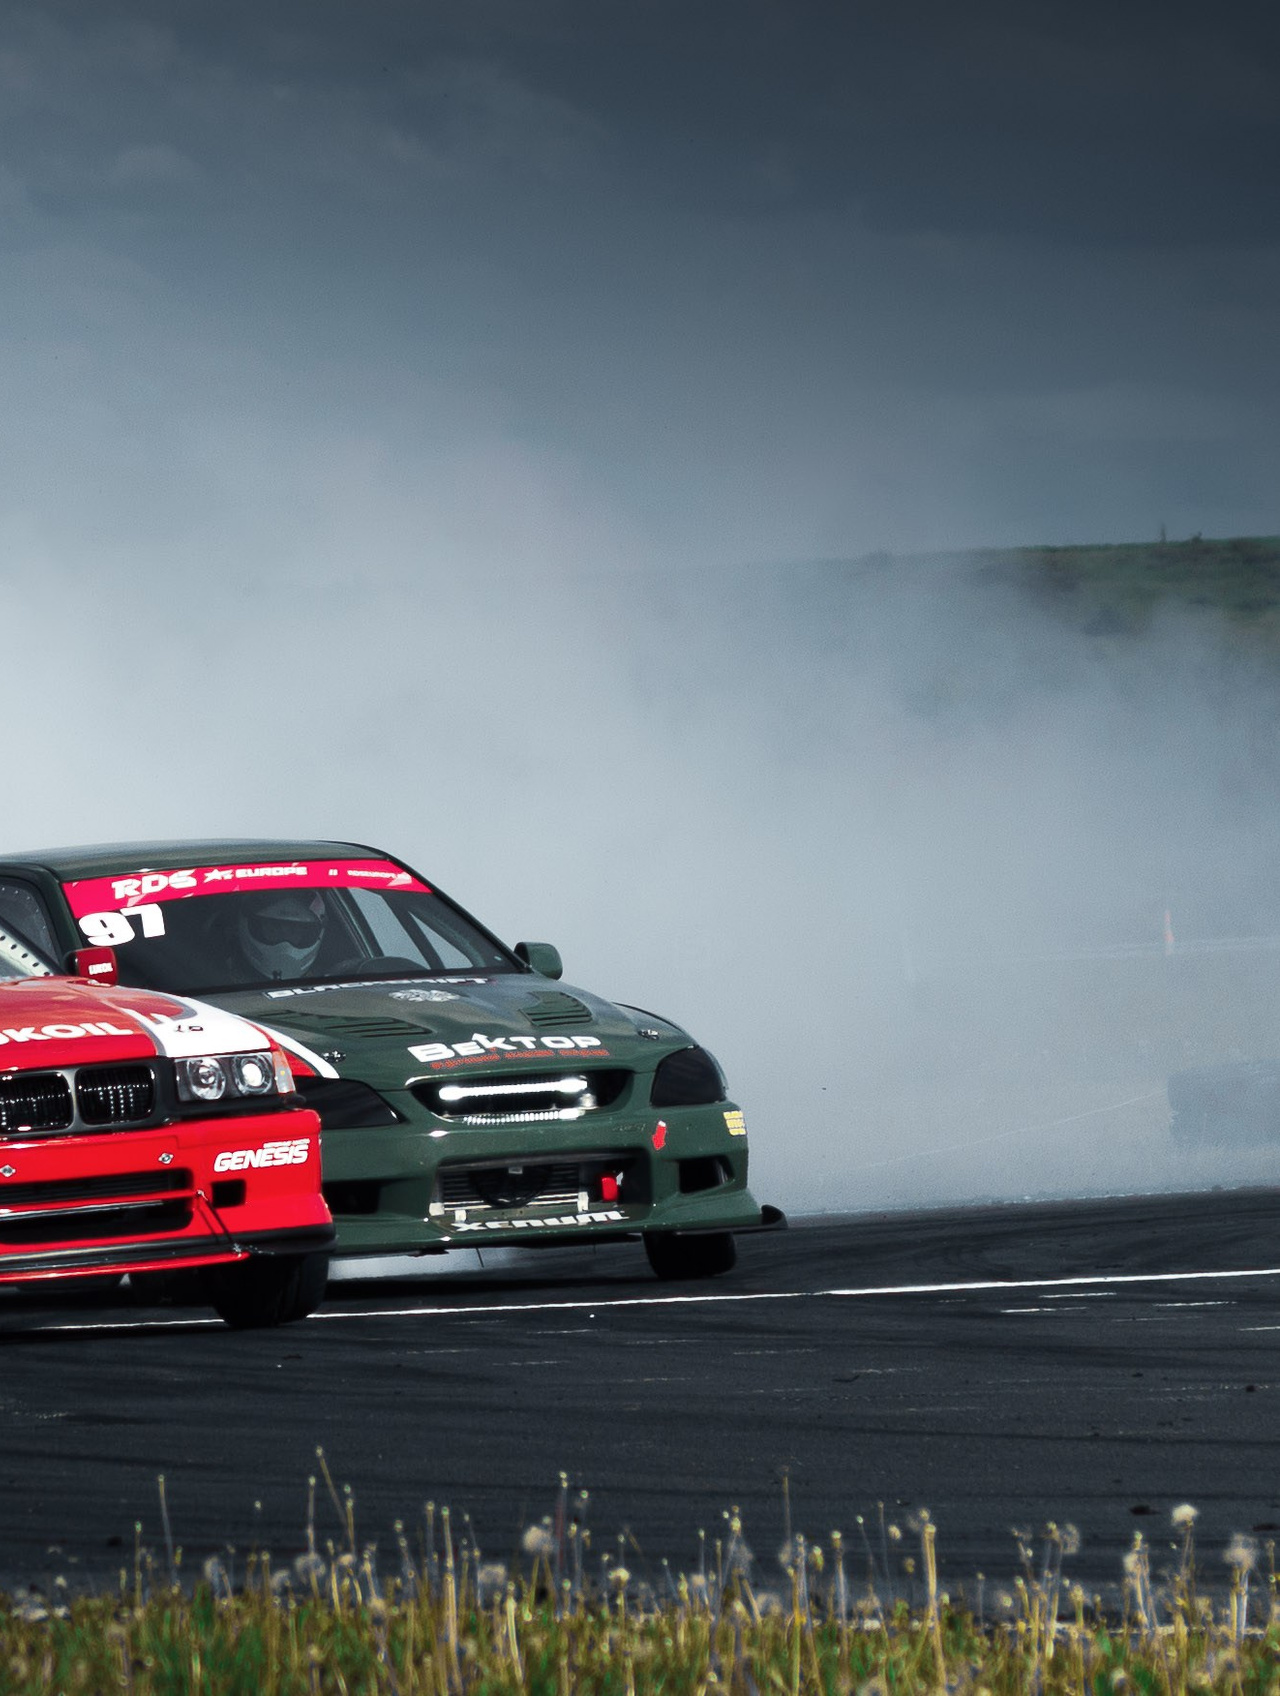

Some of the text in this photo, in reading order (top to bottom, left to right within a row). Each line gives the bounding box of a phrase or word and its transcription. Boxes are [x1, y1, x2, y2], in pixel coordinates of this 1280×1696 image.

[111, 865, 308, 900] RDS EUROPE
[78, 902, 166, 947] 97
[213, 1143, 309, 1173] GENESIS
